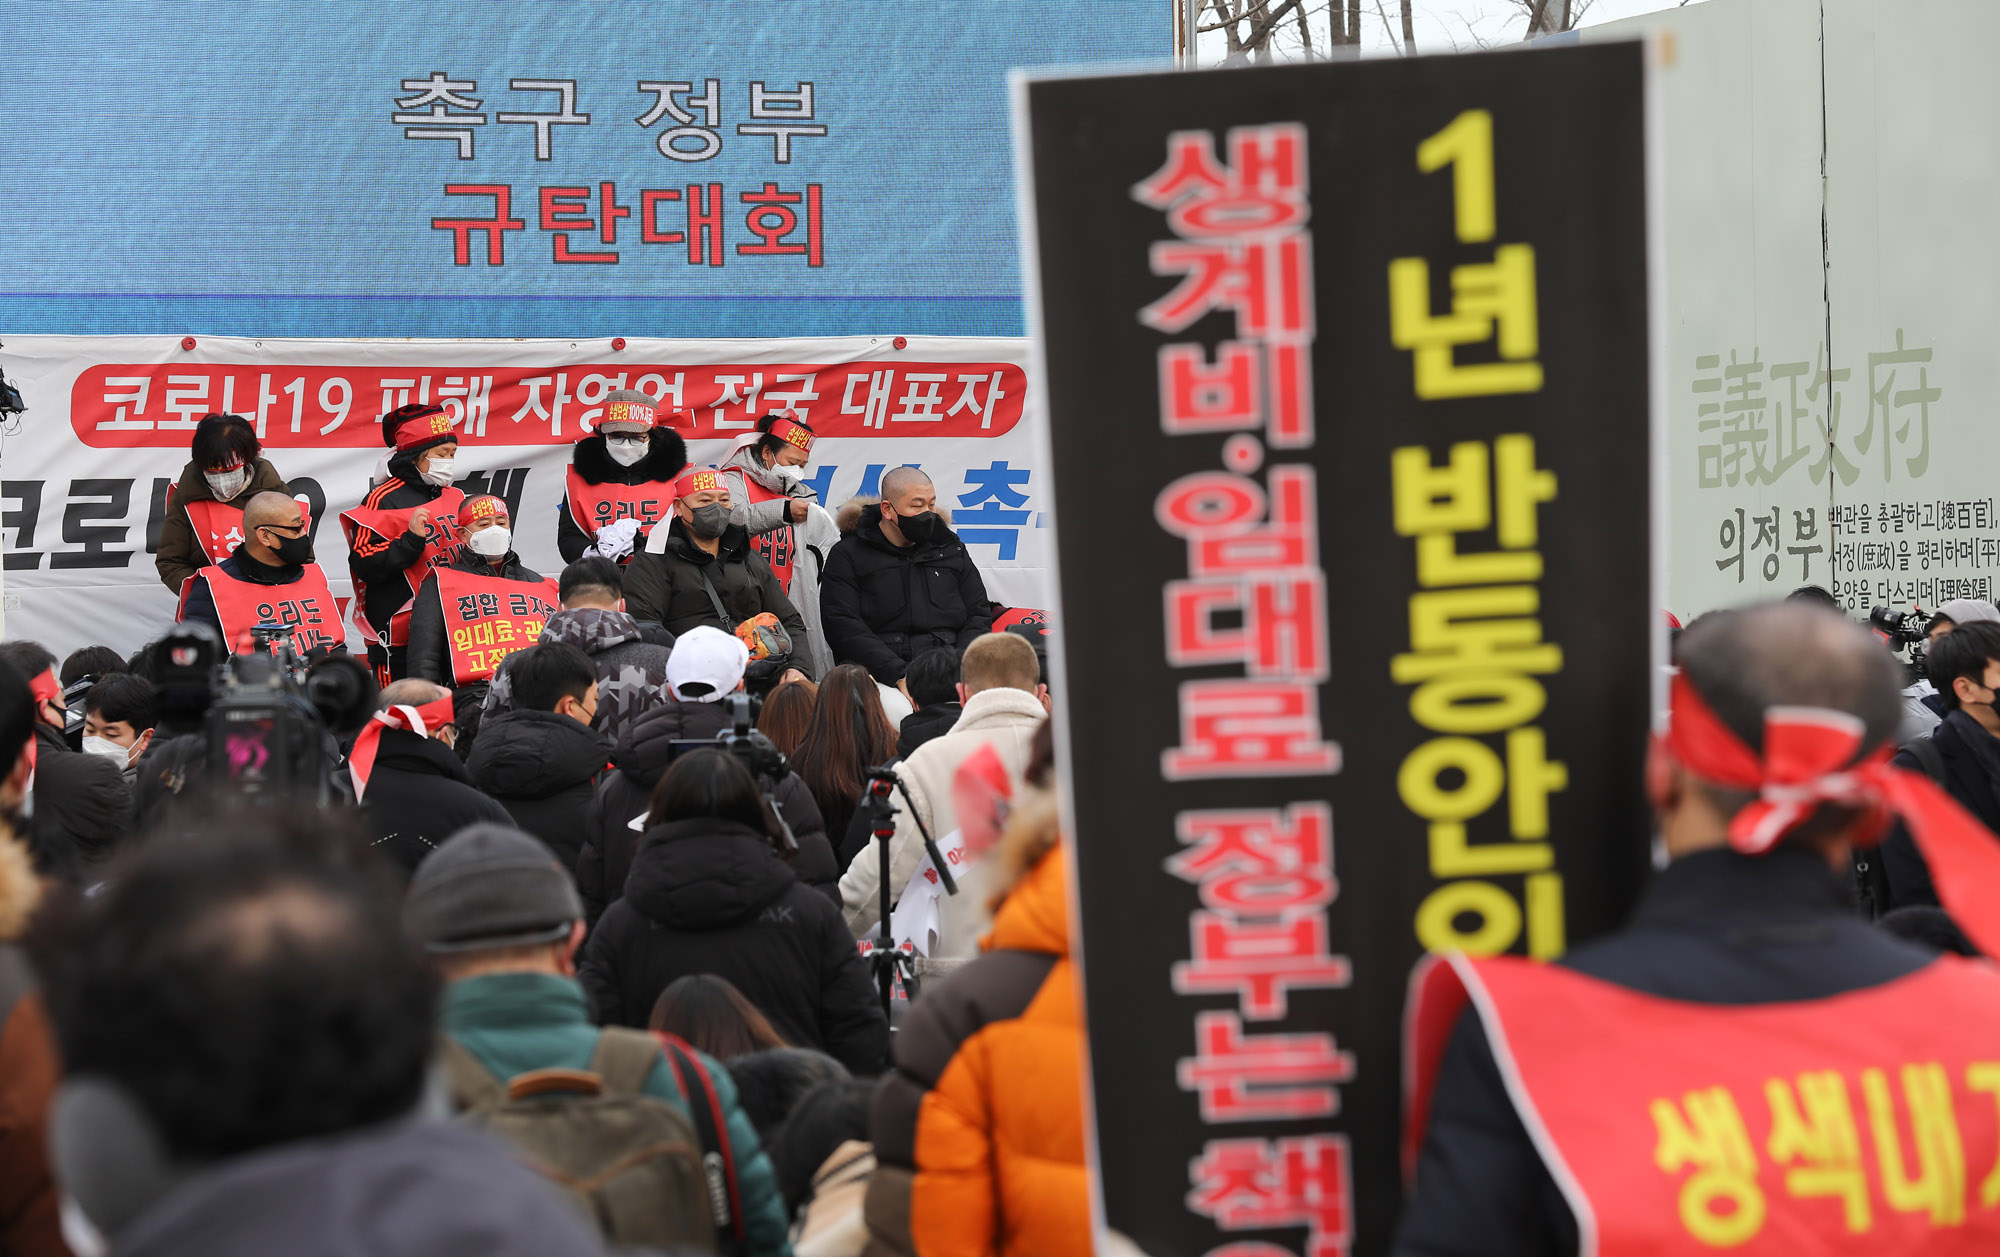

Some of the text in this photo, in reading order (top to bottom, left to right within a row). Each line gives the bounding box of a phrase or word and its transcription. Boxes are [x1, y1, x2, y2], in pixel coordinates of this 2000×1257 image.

[391, 71, 828, 164] 촉구 정부
[431, 181, 825, 268] 규탄대회
[1388, 110, 1544, 398] 1년
[96, 373, 353, 439] 코로나19
[708, 372, 820, 430] 전국
[841, 369, 1005, 430] 대표자
[1692, 328, 1942, 488] 議政府
[594, 500, 659, 526] 우리도
[951, 461, 1050, 560] 촉
[1716, 506, 1823, 583] 의정부
[1828, 504, 1872, 535] 백관을
[453, 620, 546, 651] 임대료·관
[457, 593, 499, 621] 집합
[467, 648, 526, 673] 고정
[1164, 801, 1356, 1122] 정부는
[1185, 1132, 1356, 1257] 책
